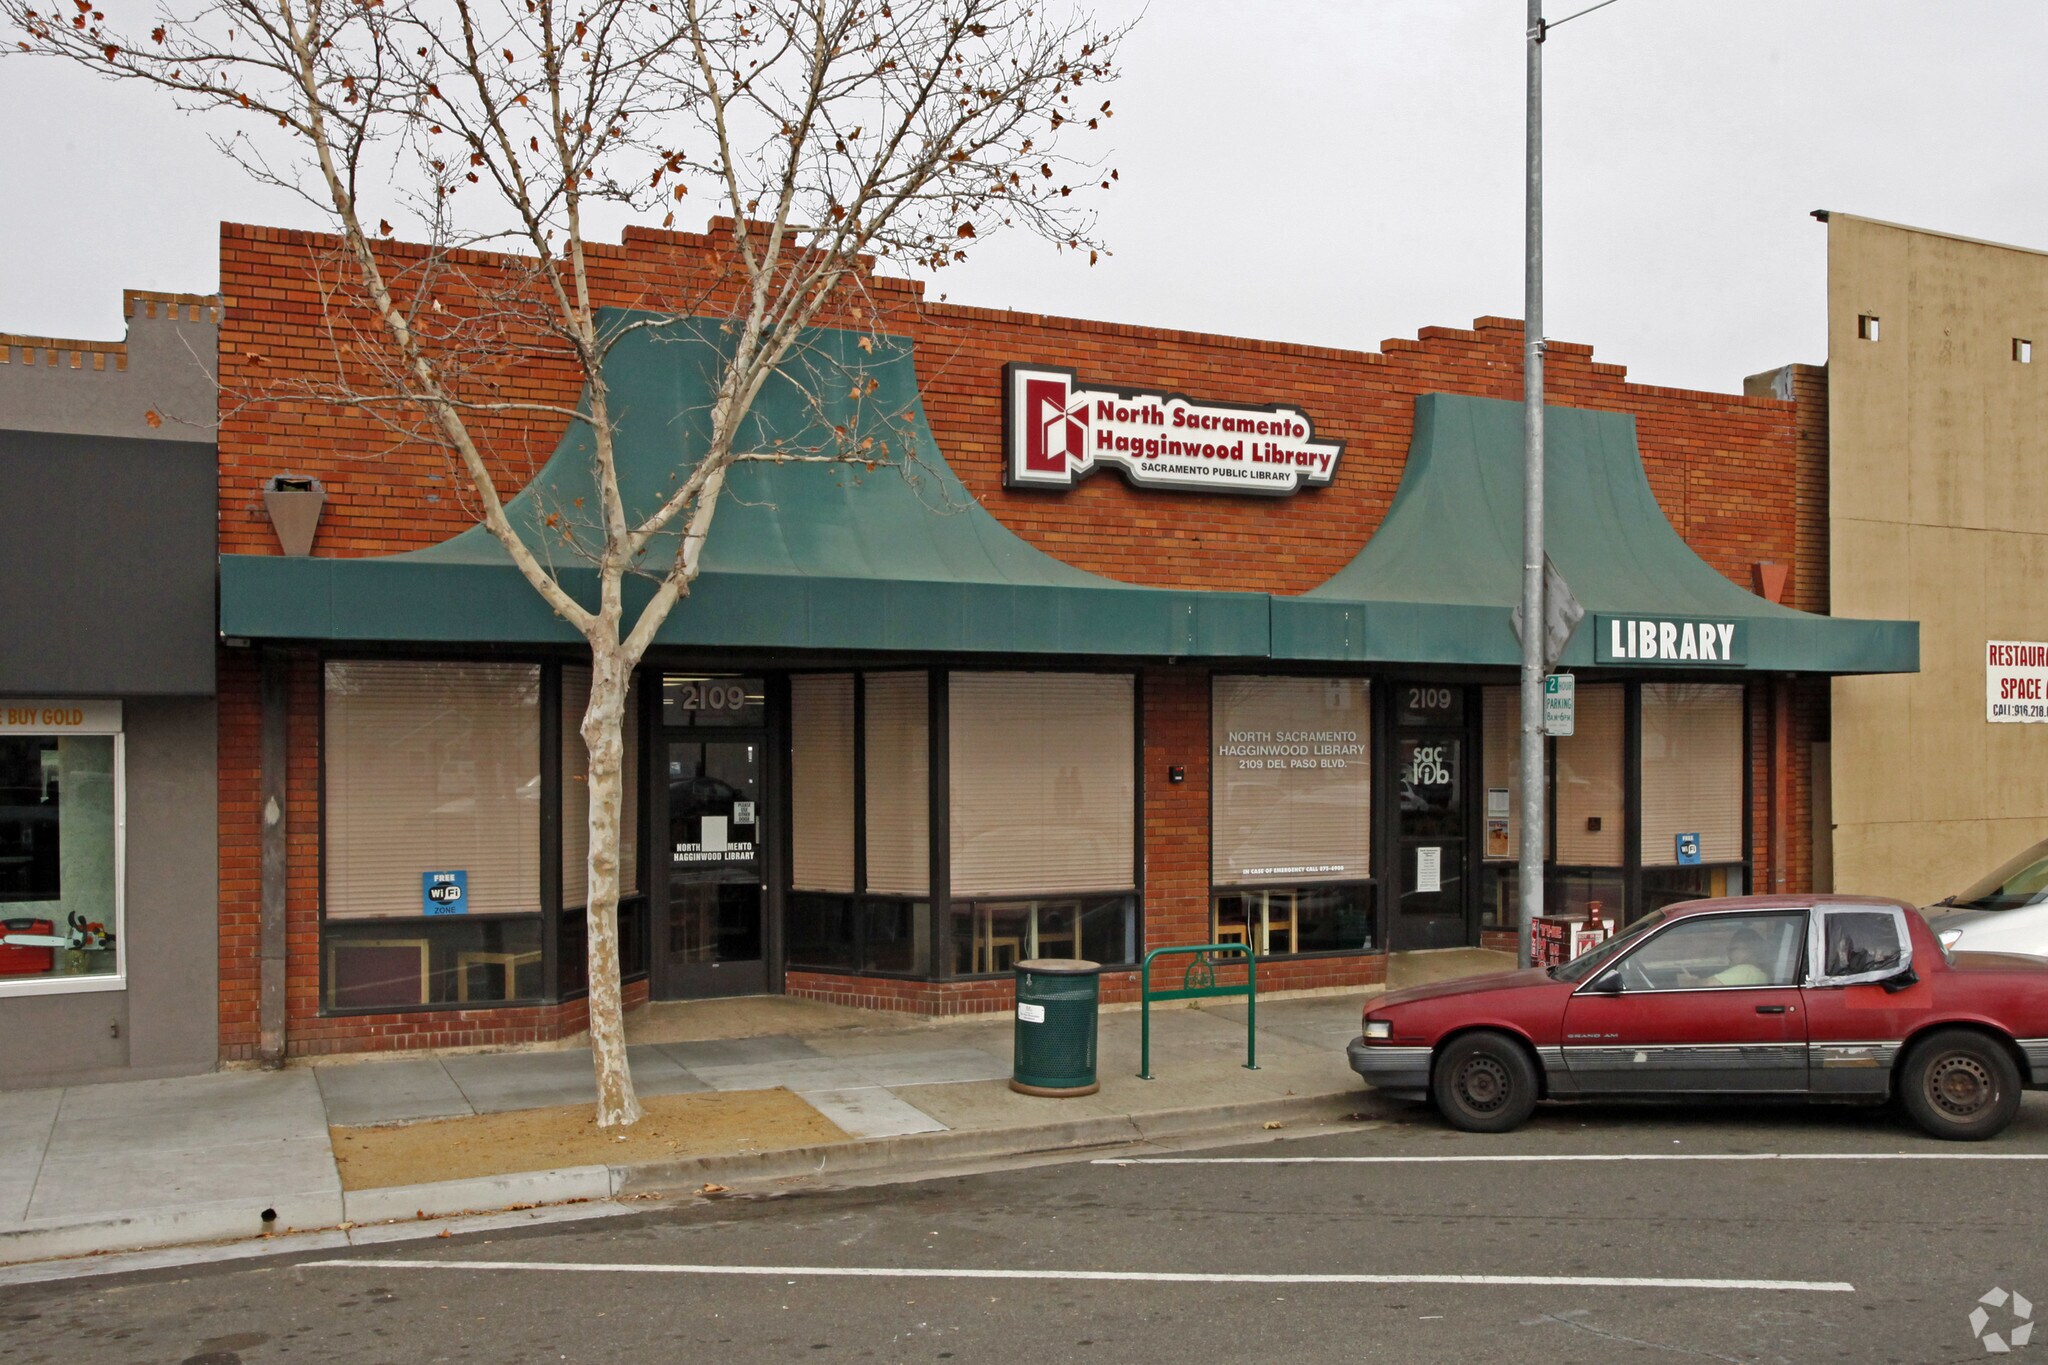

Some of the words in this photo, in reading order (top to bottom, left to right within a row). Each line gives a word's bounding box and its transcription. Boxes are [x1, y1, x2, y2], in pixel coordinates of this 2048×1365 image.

[1097, 400, 1164, 426] North
[1173, 406, 1305, 437] Sacramento
[1097, 430, 1243, 461] Hagginwood
[1252, 442, 1332, 472] Library
[1141, 462, 1210, 476] SACRAMENTO
[1212, 466, 1247, 478] PUBLIC
[1250, 469, 1291, 482] LIBRARY
[1611, 620, 1735, 660] LIBRARY
[1550, 678, 1556, 691] 2
[2001, 678, 2041, 699] SPACE
[682, 686, 744, 710] 2109
[1409, 688, 1451, 709] 2109
[1546, 698, 1572, 709] PARKING
[8, 708, 38, 725] BUY
[42, 708, 83, 725] GOLD
[1229, 731, 1271, 742] NORTH
[1276, 731, 1357, 742] SACRAMENTO
[1219, 745, 1308, 756] HAGGINWOOD
[1314, 745, 1365, 755] LIBRARY
[1413, 747, 1443, 763] sac
[1239, 759, 1263, 769] 2109
[1267, 759, 1286, 768] DEL
[1290, 759, 1316, 768] PASO
[1321, 759, 1347, 768] BLVD.
[676, 843, 700, 852] NORTH
[673, 852, 721, 861] HAGGINWOOD
[725, 852, 755, 860] LIBRARY
[434, 874, 455, 882] FREE
[1540, 924, 1561, 938] THE
